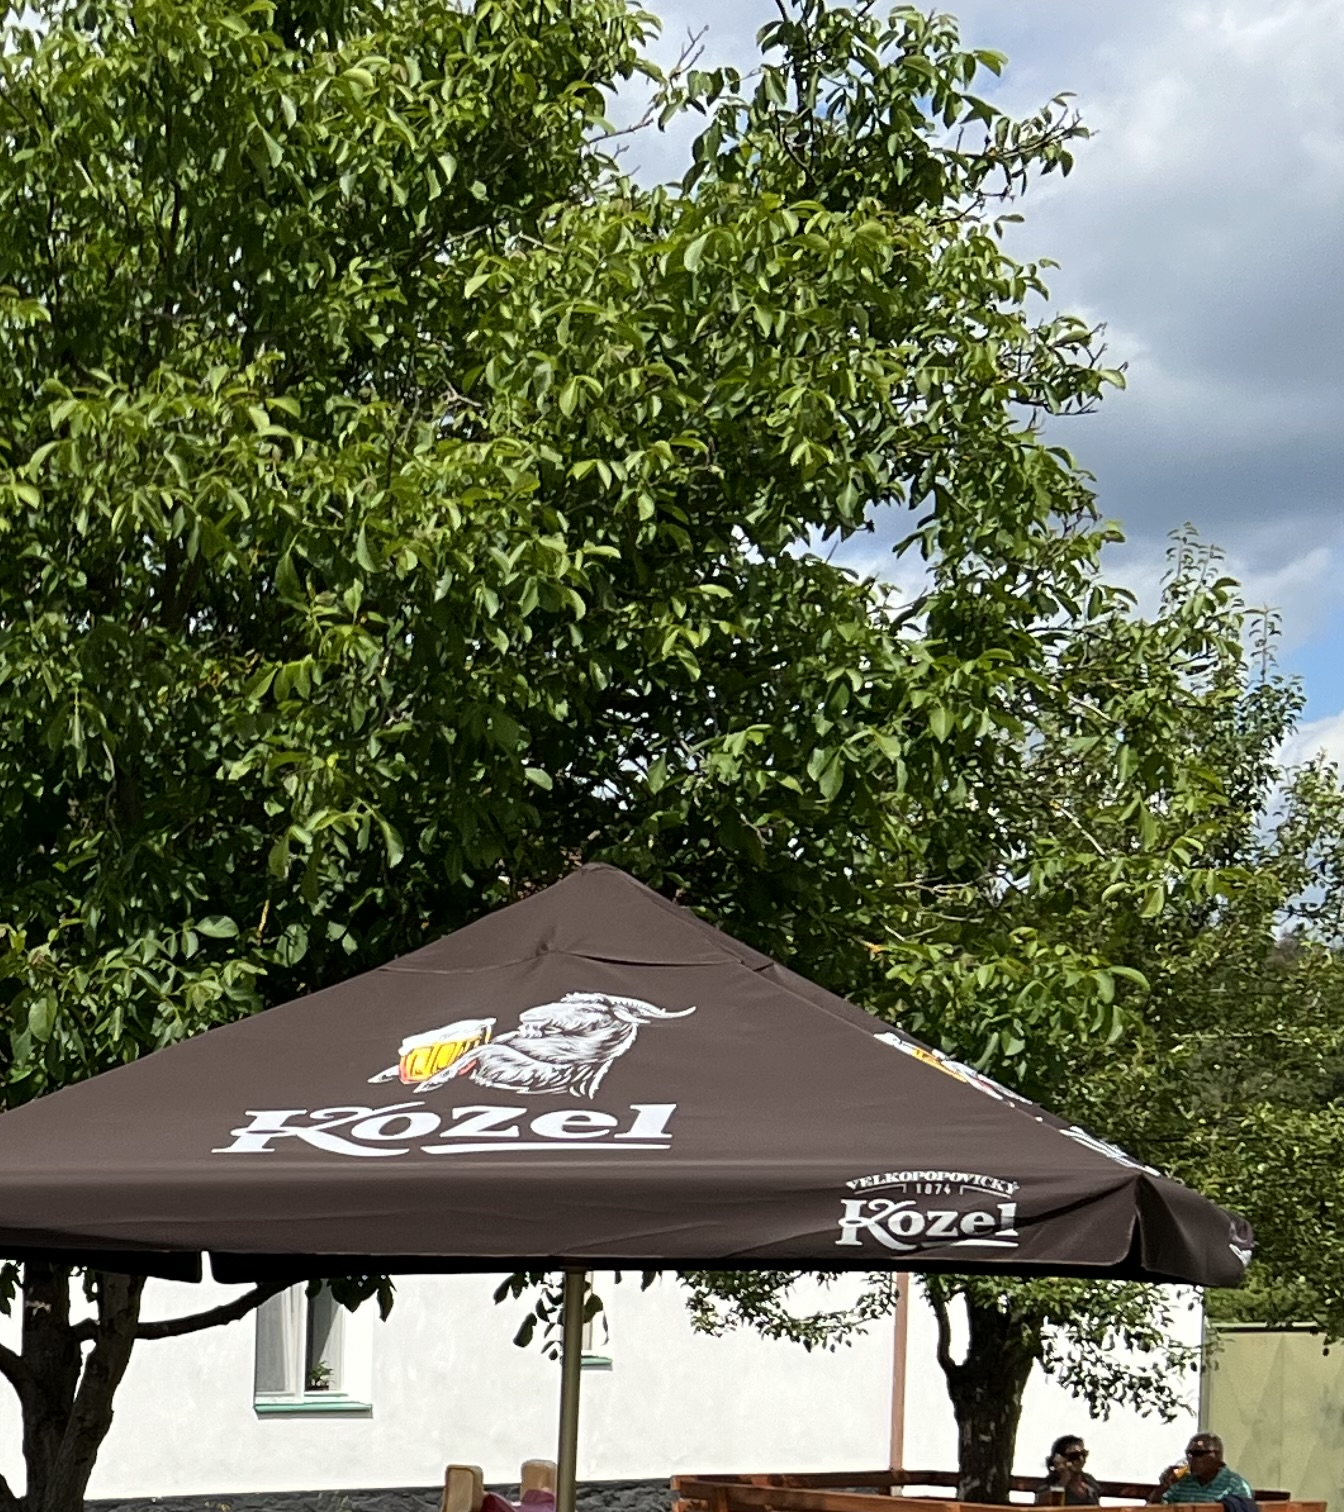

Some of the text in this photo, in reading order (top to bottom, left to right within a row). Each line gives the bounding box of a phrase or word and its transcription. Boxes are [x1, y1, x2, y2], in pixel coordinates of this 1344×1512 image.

[211, 1101, 678, 1157] Kozel
[915, 1183, 952, 1196] 1874
[834, 1197, 1020, 1251] Kozel
